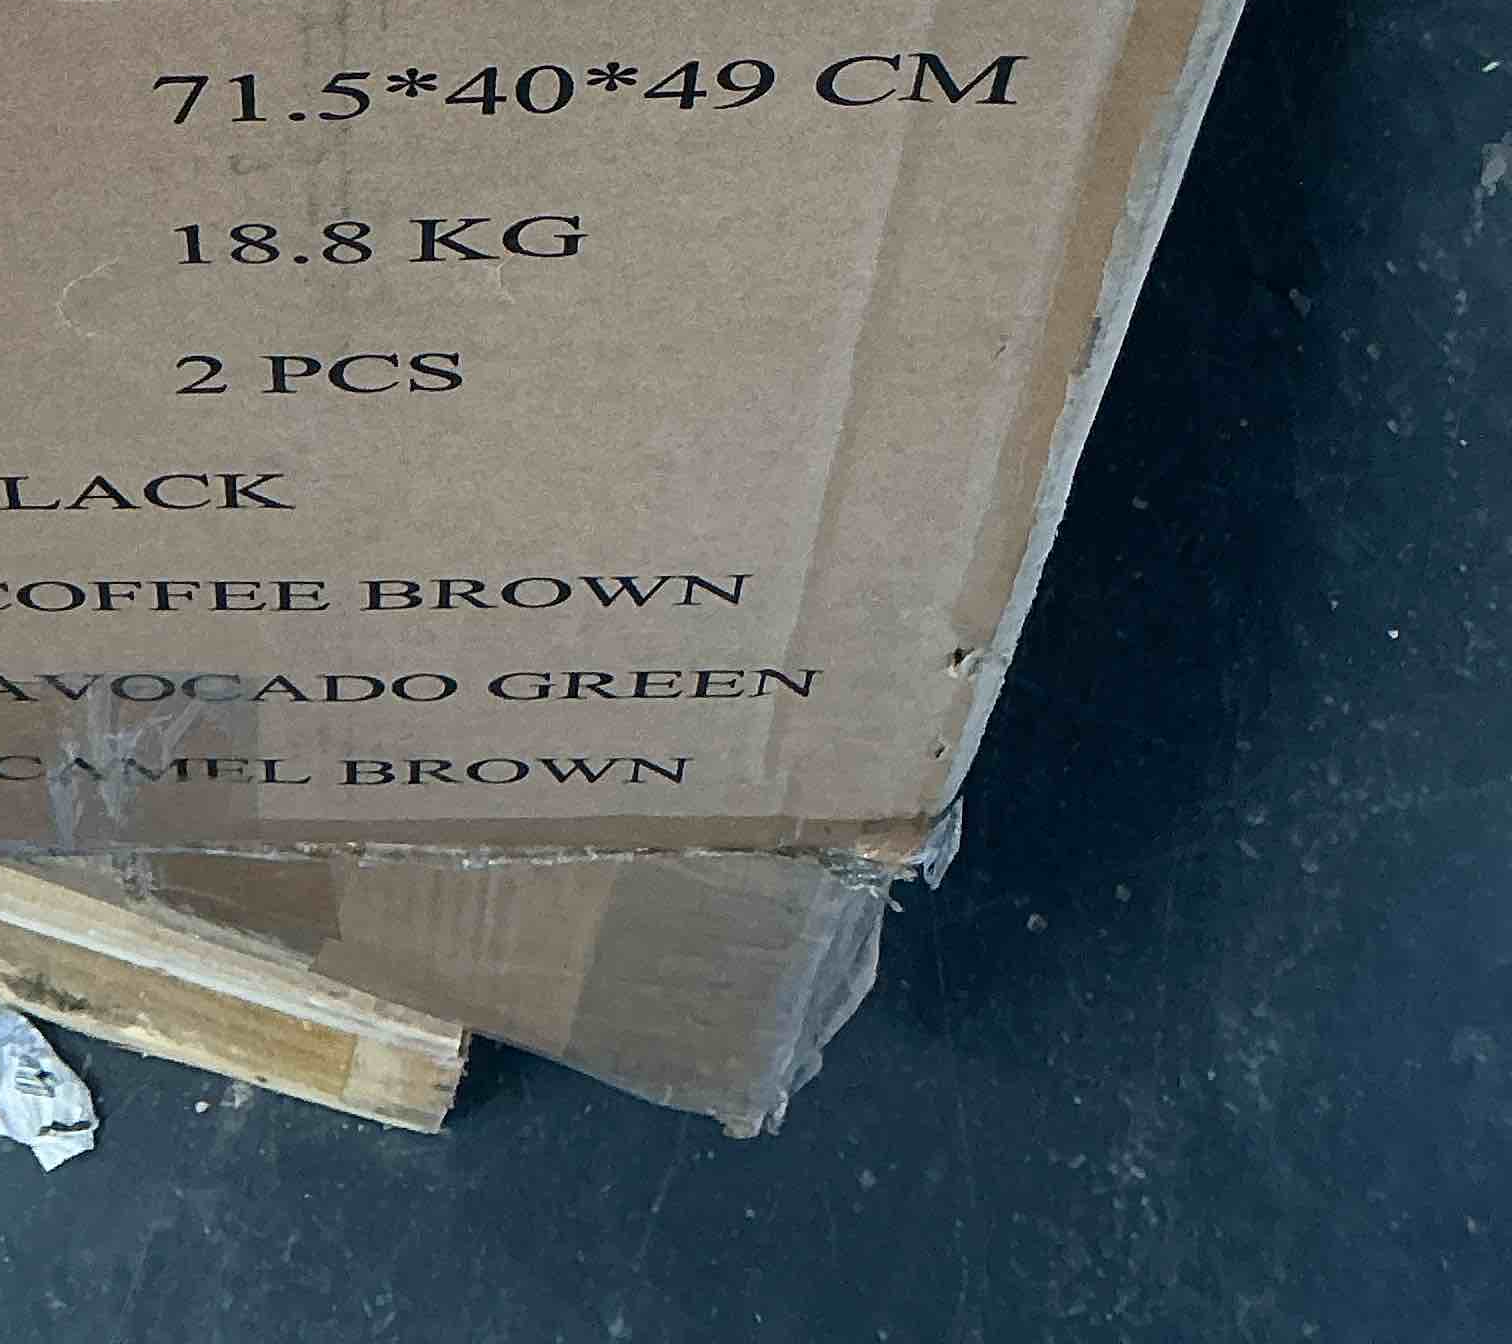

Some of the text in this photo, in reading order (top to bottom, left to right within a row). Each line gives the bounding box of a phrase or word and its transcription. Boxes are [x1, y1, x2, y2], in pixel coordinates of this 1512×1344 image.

[814, 52, 1029, 108] CM
[174, 219, 373, 266] 18.8
[409, 214, 589, 263] KG
[175, 353, 228, 395] 2
[260, 350, 466, 396] PCS
[360, 573, 754, 611] BROWN
[487, 667, 822, 703] GREEN
[338, 755, 693, 788] BROWN
